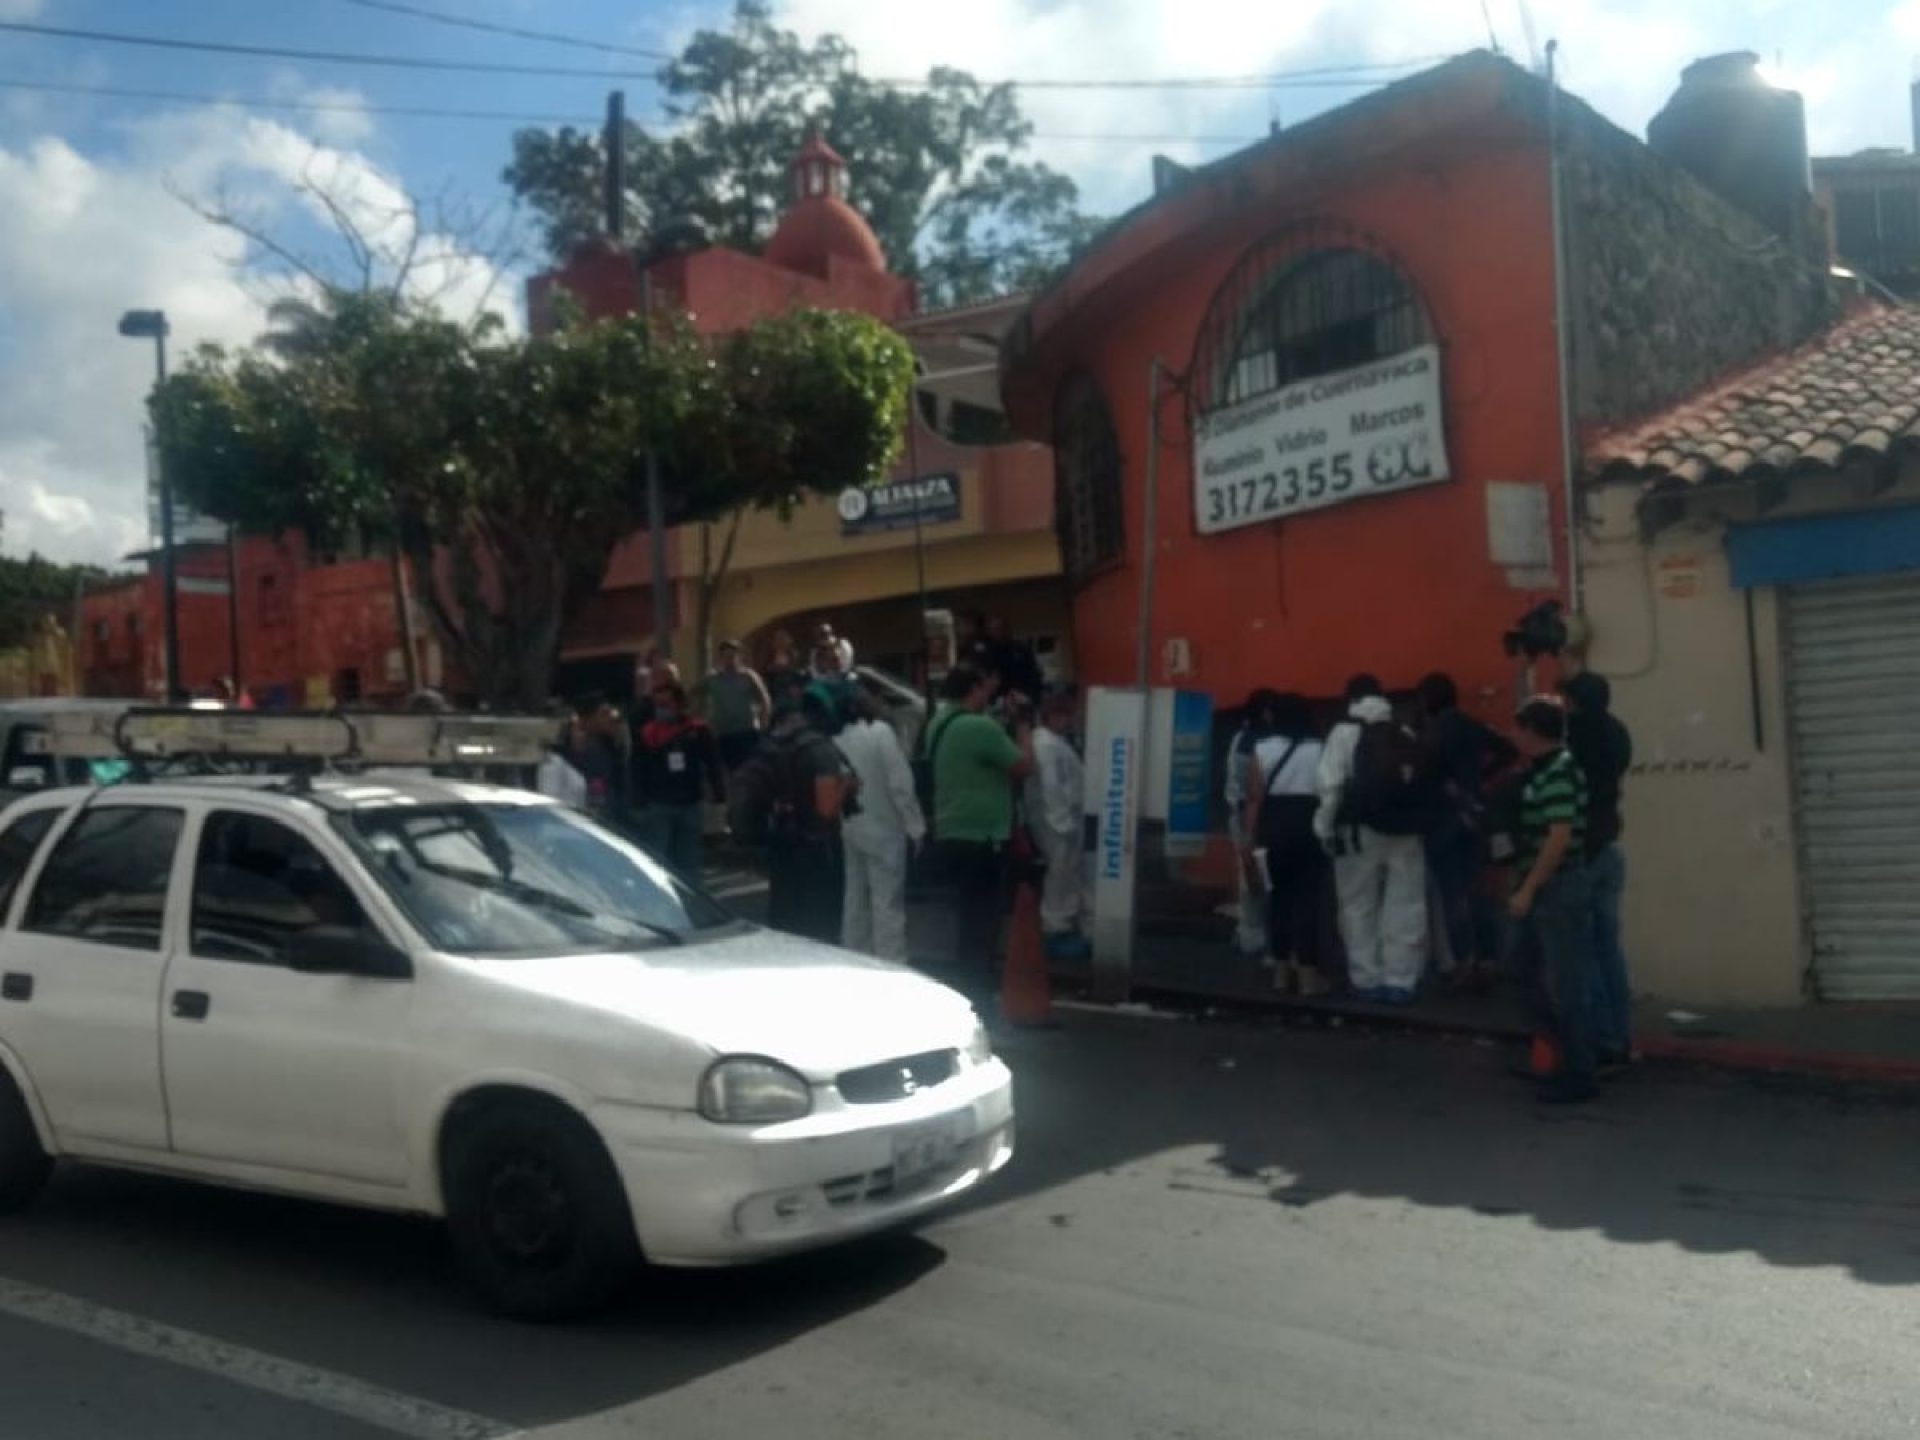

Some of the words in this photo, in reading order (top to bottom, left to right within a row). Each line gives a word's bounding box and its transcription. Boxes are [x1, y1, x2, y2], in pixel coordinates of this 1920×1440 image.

[1274, 427, 1328, 454] Vidrio
[1350, 403, 1426, 435] Marcos
[1284, 389, 1306, 409] de
[1208, 453, 1354, 522] 3172355
[1103, 737, 1126, 878] infinitum
